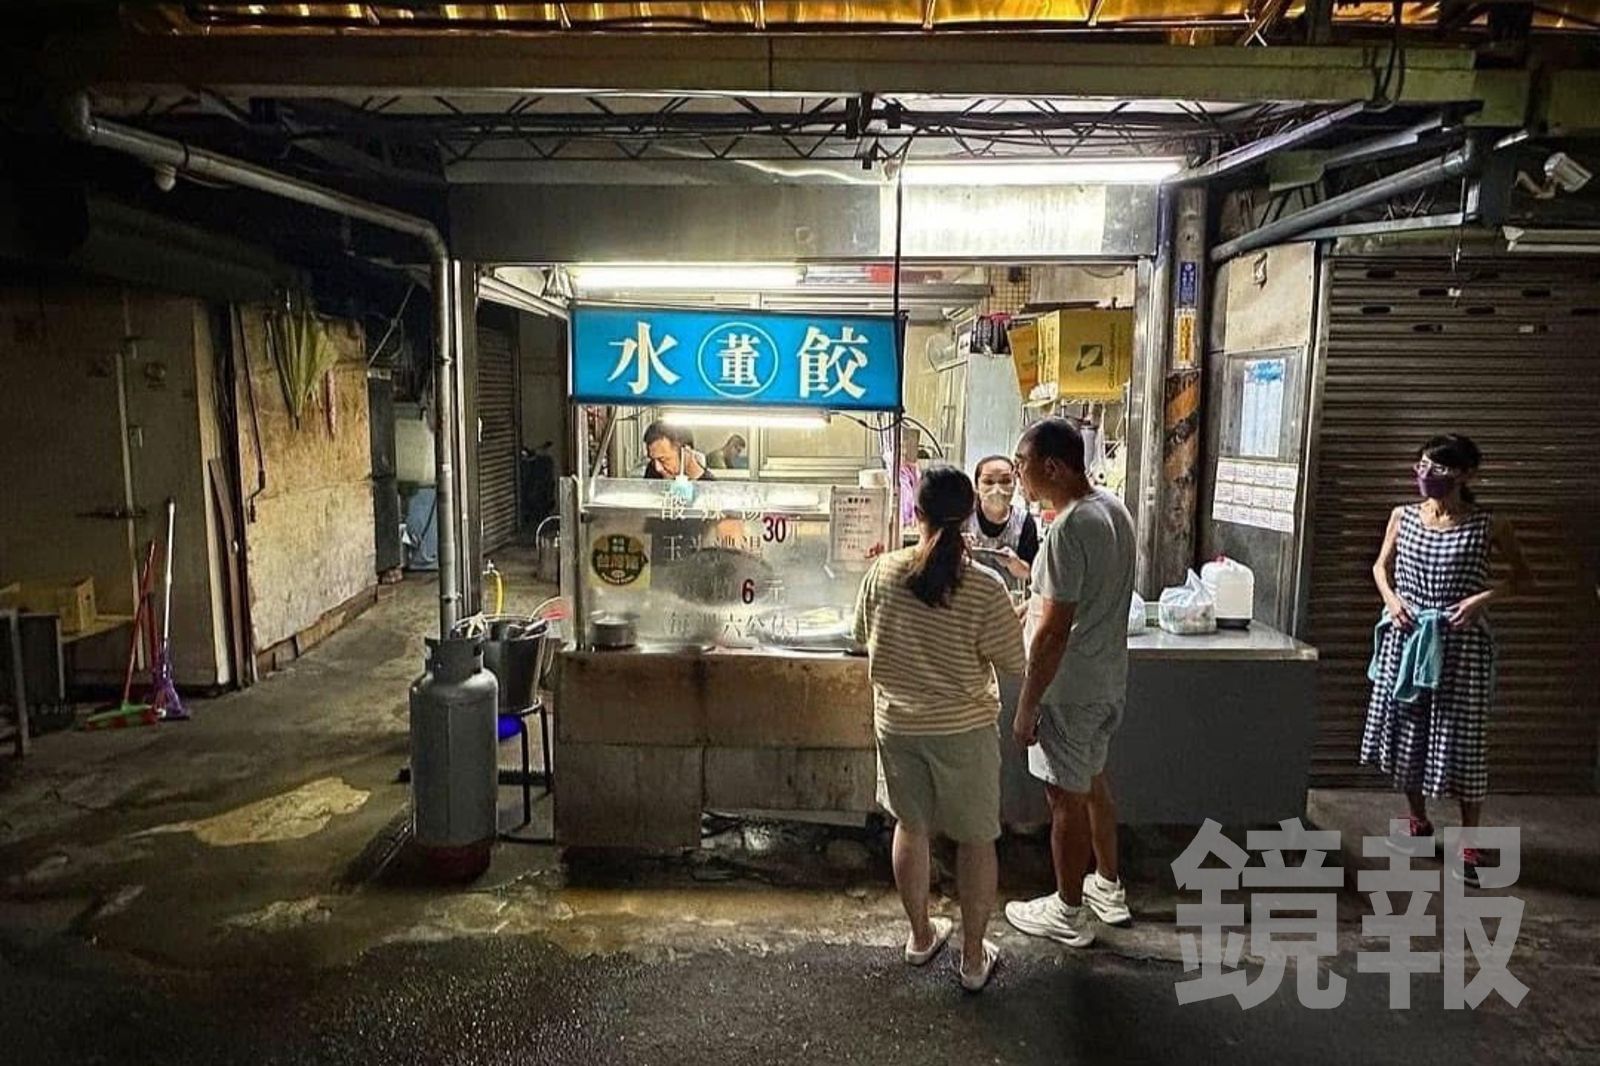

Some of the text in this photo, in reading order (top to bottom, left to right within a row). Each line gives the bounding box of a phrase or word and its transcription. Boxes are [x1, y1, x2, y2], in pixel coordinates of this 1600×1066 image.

[607, 321, 869, 399] 水董餃
[762, 516, 787, 543] 30
